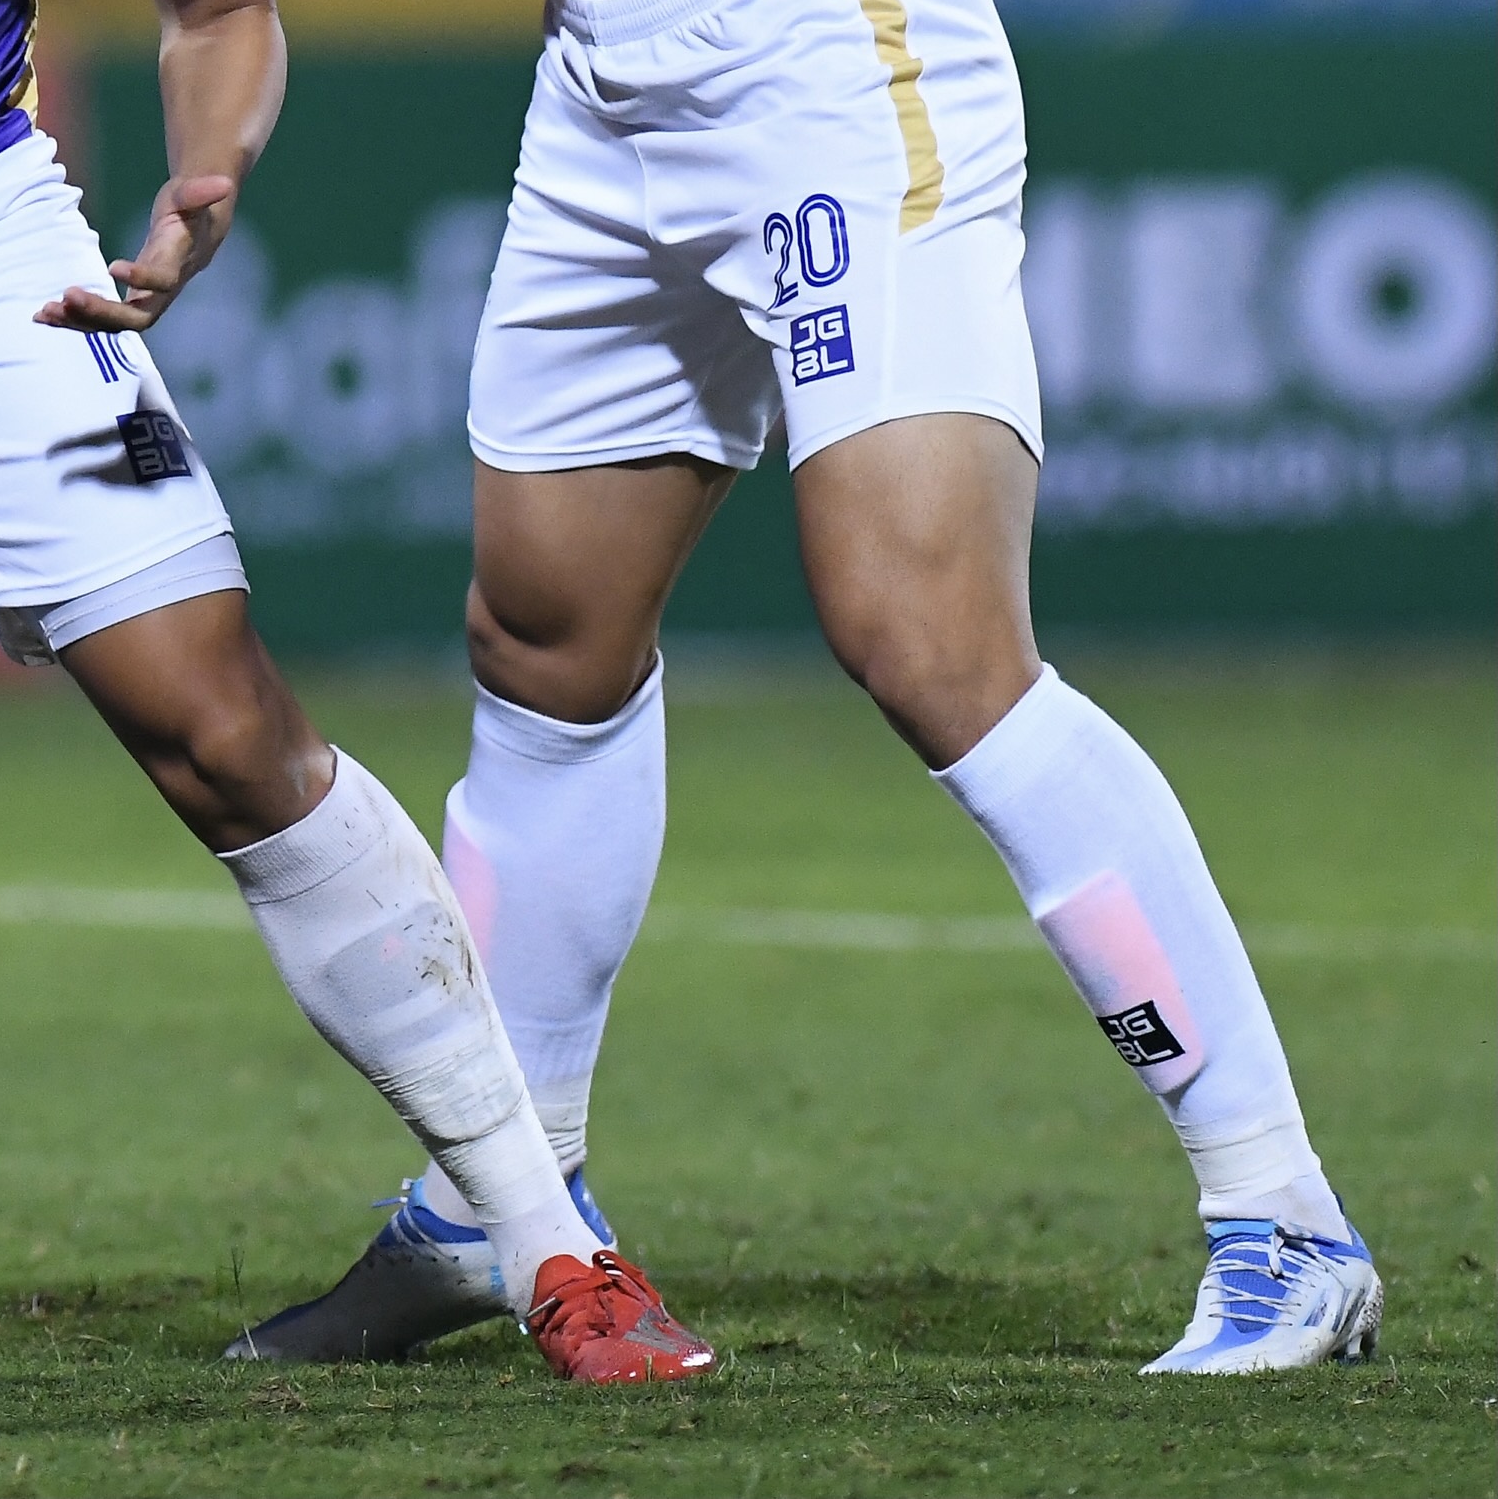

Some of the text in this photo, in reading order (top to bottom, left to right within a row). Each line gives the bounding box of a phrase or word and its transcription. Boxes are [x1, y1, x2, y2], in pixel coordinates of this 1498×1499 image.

[763, 193, 851, 311] 20
[793, 311, 845, 350] JG
[795, 345, 849, 380] BL
[131, 416, 177, 446] JG
[135, 446, 188, 476] BL
[1107, 1008, 1157, 1039] JG
